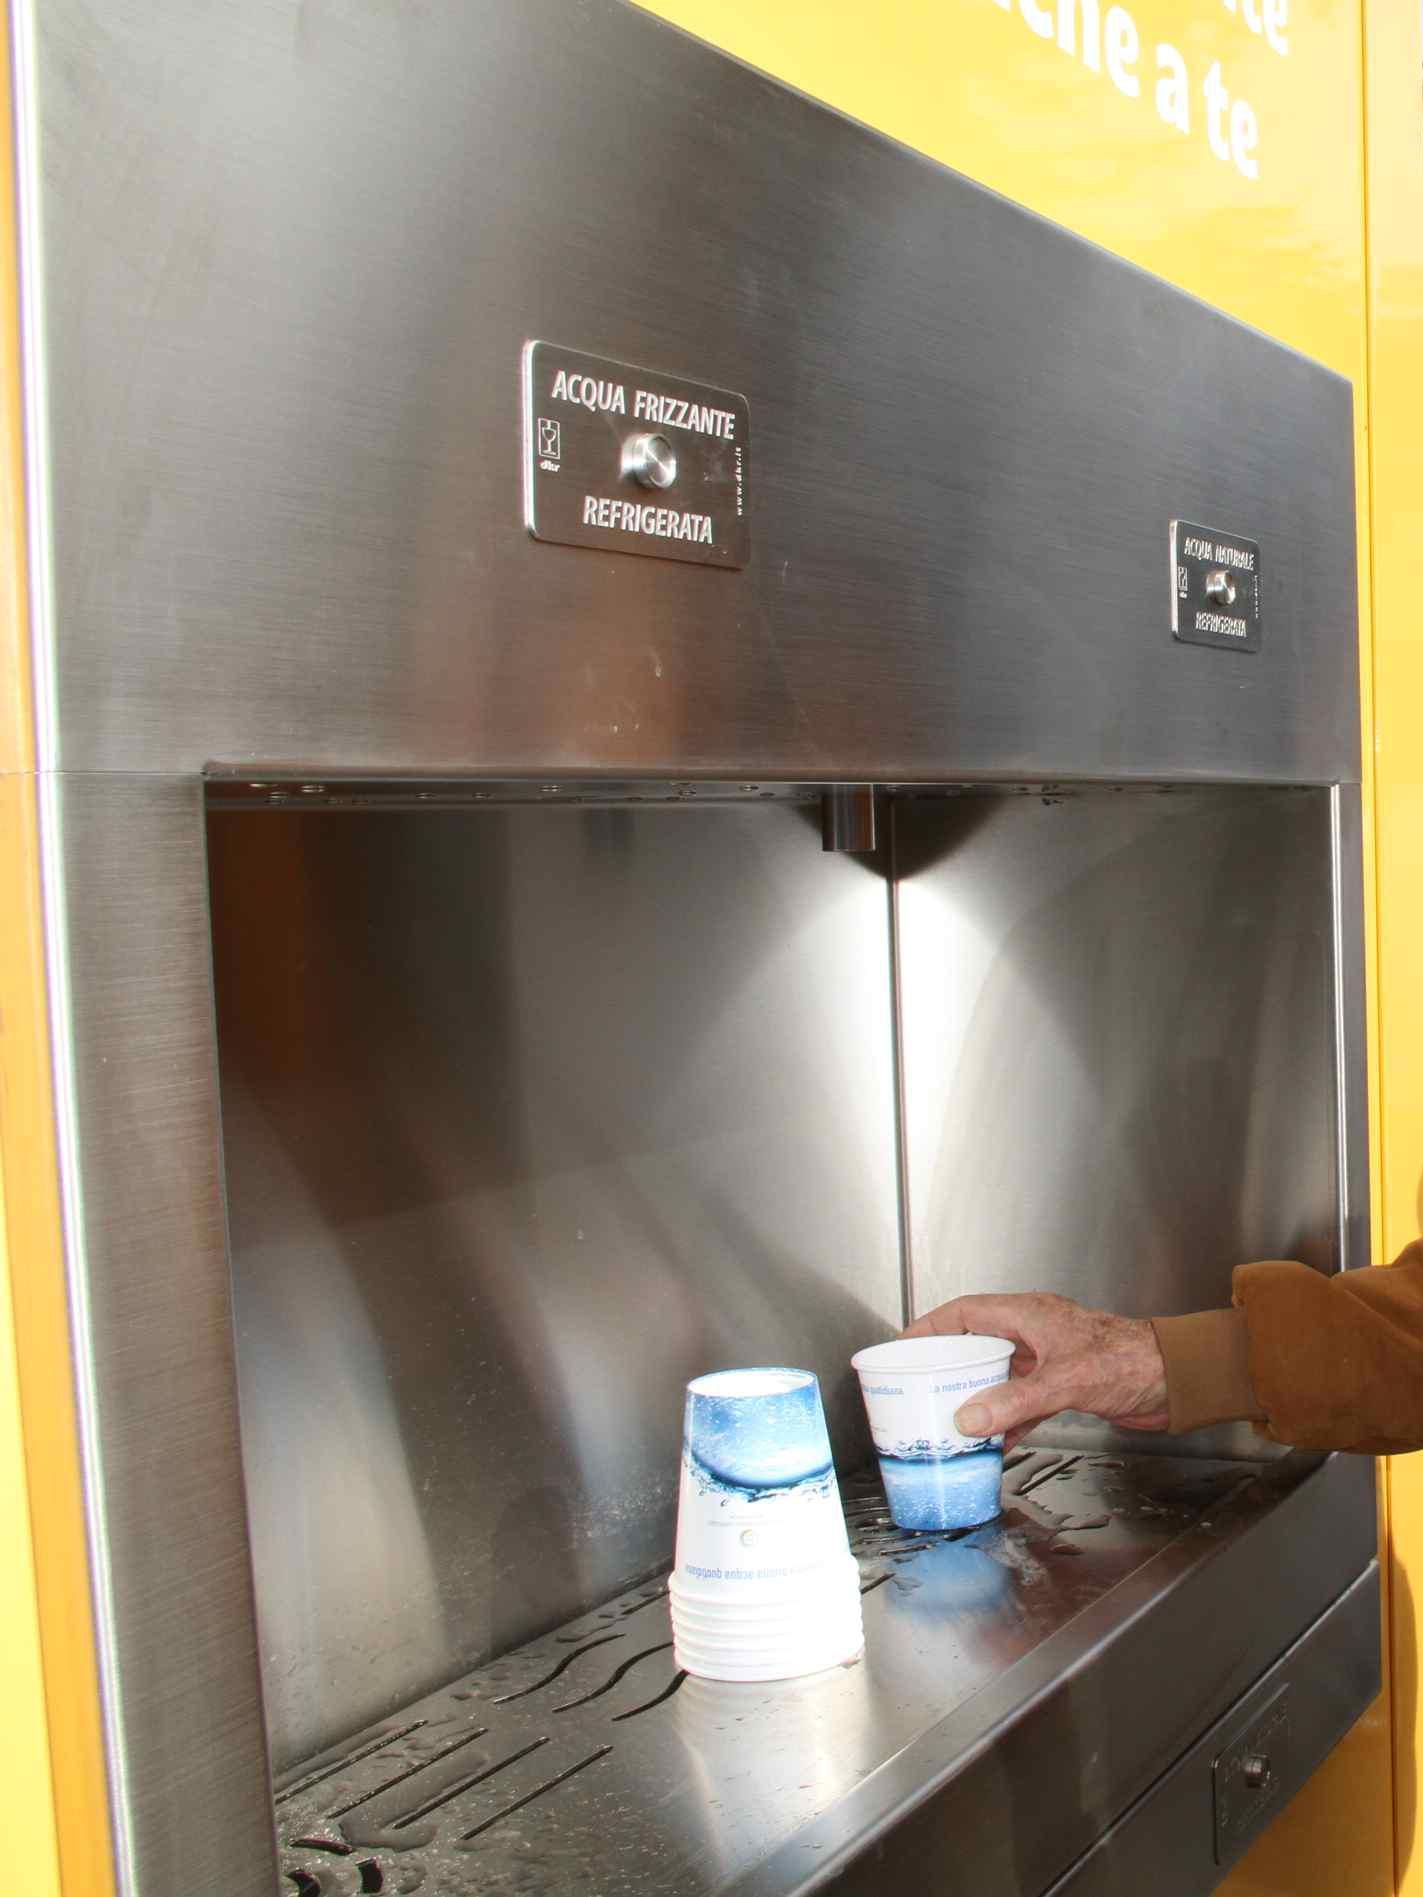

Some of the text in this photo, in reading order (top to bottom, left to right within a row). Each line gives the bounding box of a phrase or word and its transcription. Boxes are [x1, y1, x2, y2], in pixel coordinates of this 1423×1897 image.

[1156, 43, 1190, 135] a
[1204, 60, 1259, 180] te
[551, 370, 736, 440] ACQUA FRIZZANTE
[583, 495, 713, 544] REFRIGERATA
[1184, 537, 1254, 571] ACQUA NATURALE
[1195, 611, 1247, 637] REFRIGERATA
